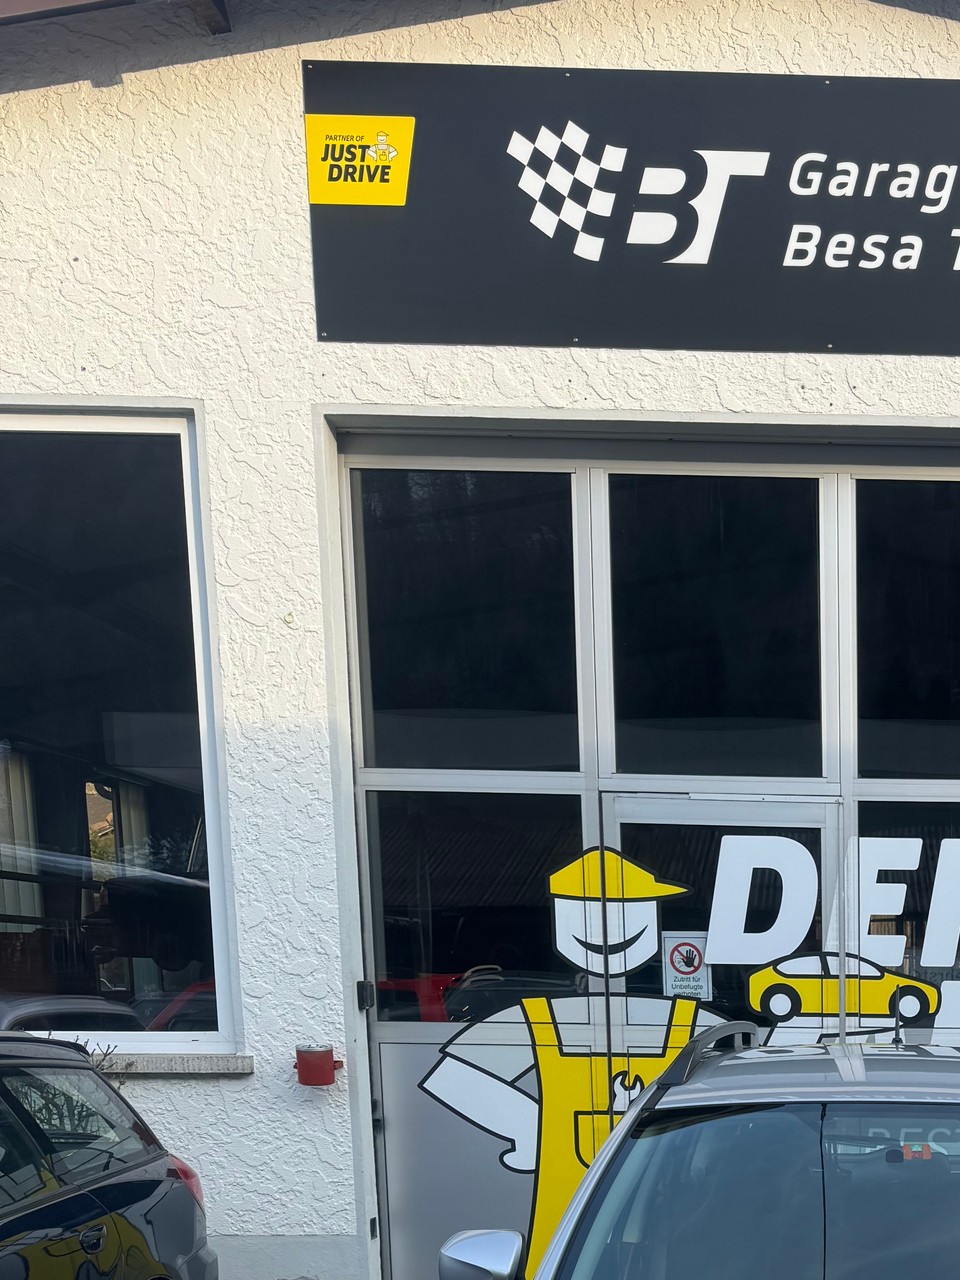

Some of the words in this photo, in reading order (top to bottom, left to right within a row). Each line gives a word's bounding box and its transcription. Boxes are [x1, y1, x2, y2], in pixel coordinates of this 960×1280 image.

[325, 134, 355, 142] PARTNER
[321, 144, 370, 162] JUST
[328, 164, 391, 183] DRIVE
[626, 149, 771, 264] BT
[782, 224, 923, 270] Besa
